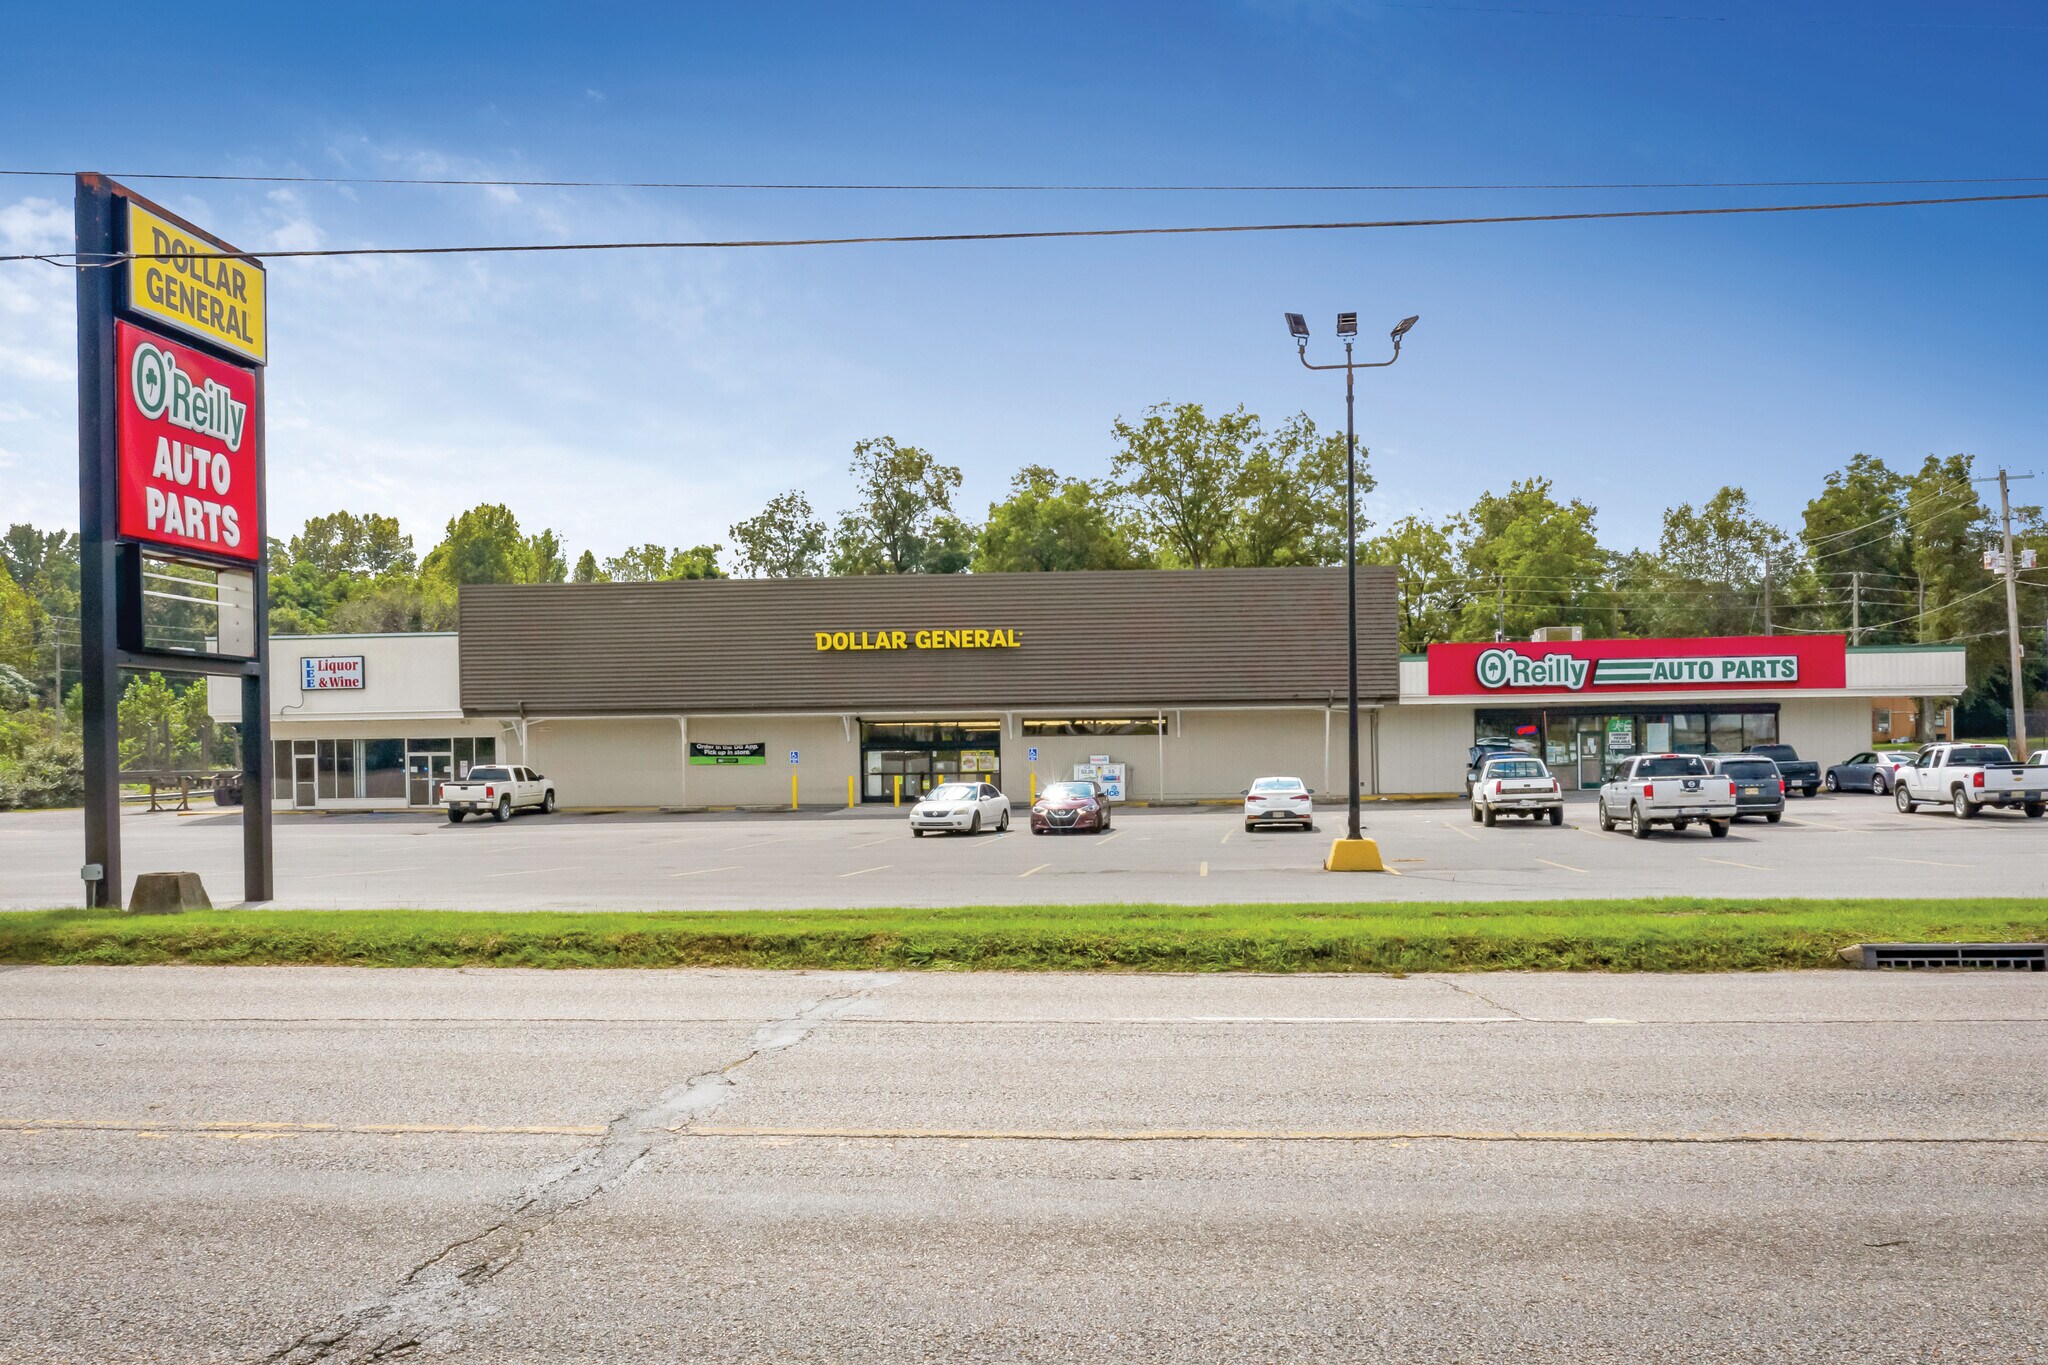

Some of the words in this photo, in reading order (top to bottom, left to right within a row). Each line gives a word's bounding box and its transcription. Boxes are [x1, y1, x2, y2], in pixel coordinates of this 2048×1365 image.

[151, 226, 248, 304] DOLLAR
[145, 267, 254, 345] GENERAL
[135, 346, 246, 449] O'Reilly
[152, 435, 232, 496] AUTO
[145, 486, 241, 548] PARTS
[317, 659, 358, 674] Liquor
[815, 631, 908, 651] DOLLAR
[915, 629, 1021, 649] GENERAL
[1479, 651, 1587, 688] O'Reilly
[1652, 660, 1714, 682] AUTO
[1721, 658, 1796, 680] PARTS
[318, 677, 328, 688] &
[329, 676, 359, 688] Wine
